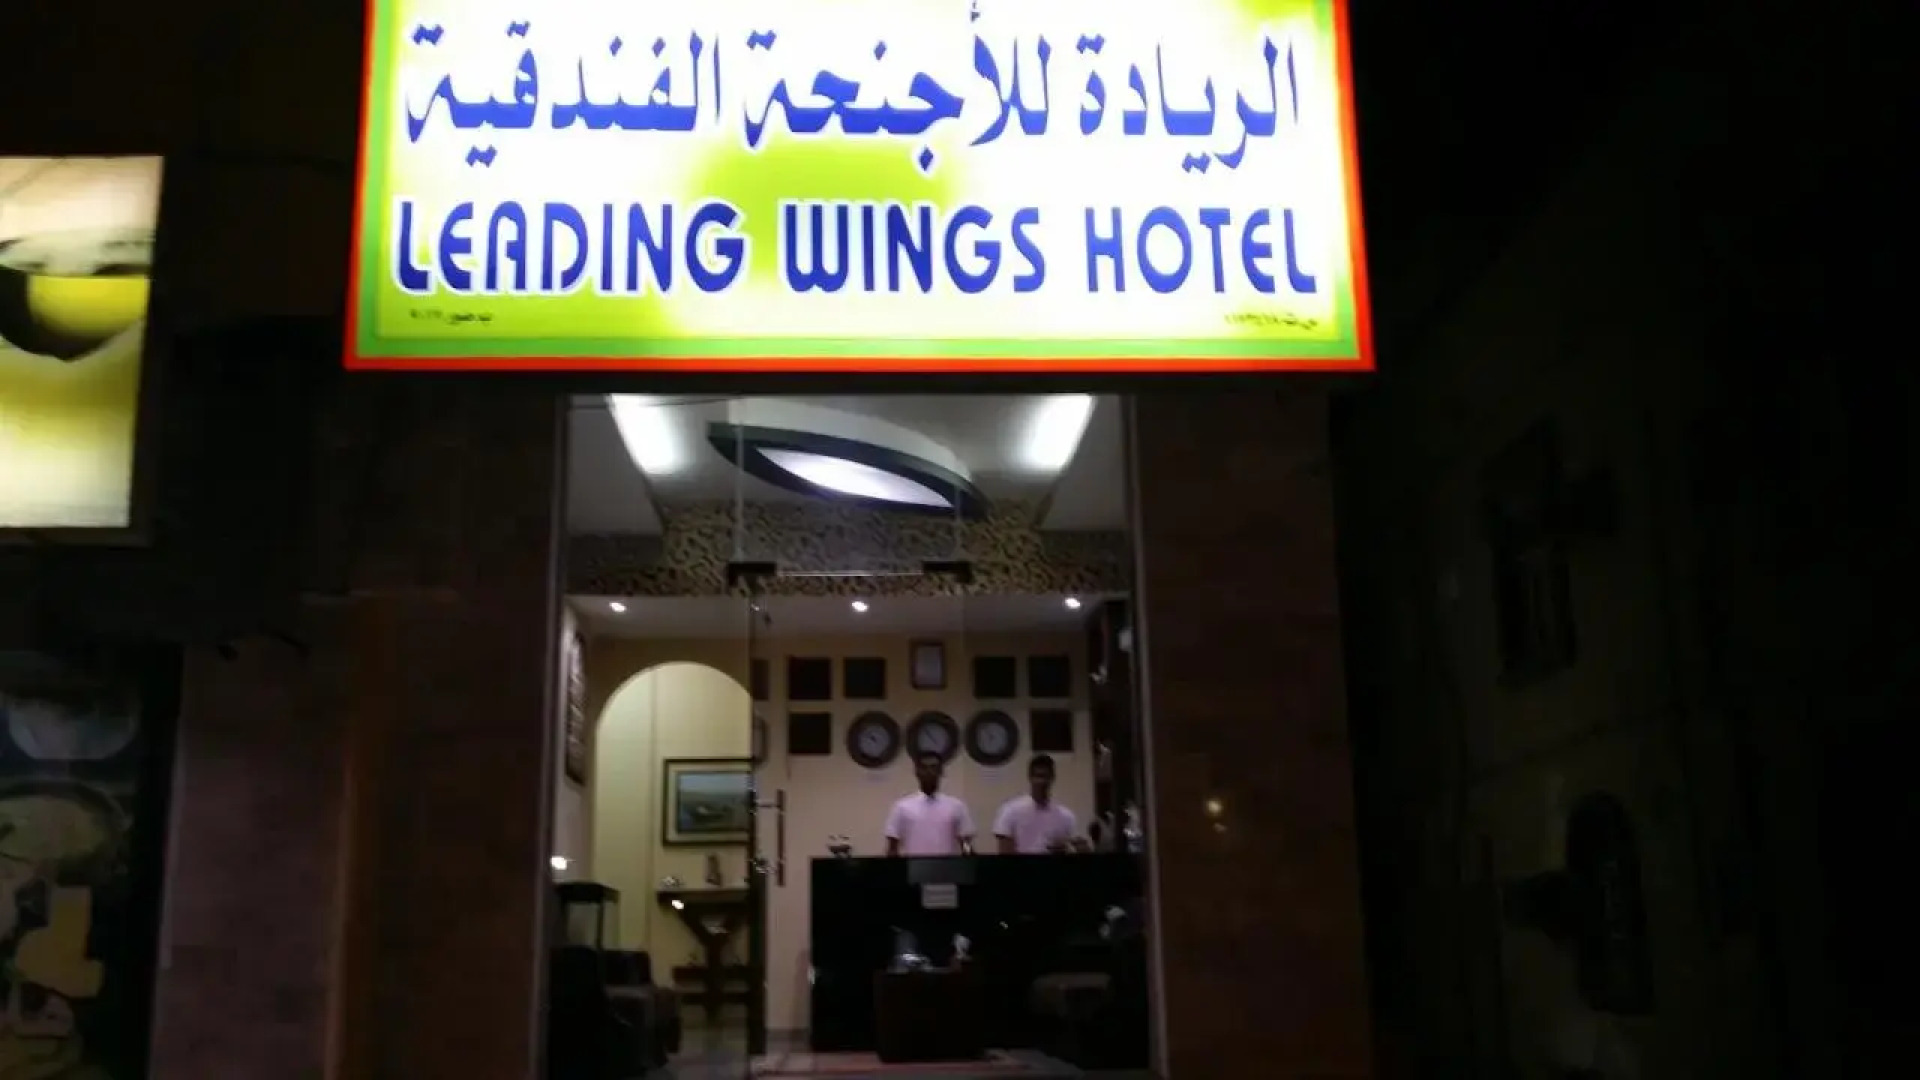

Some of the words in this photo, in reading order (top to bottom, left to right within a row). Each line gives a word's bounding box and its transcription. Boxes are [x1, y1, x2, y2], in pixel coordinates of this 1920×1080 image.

[406, 21, 722, 167] الفندقية
[743, 0, 1052, 172] للأجنحة
[1075, 34, 1298, 174] الريادة
[398, 200, 745, 293] LEADING
[783, 203, 1046, 294] WINGS
[1084, 206, 1318, 294] HOTEL
